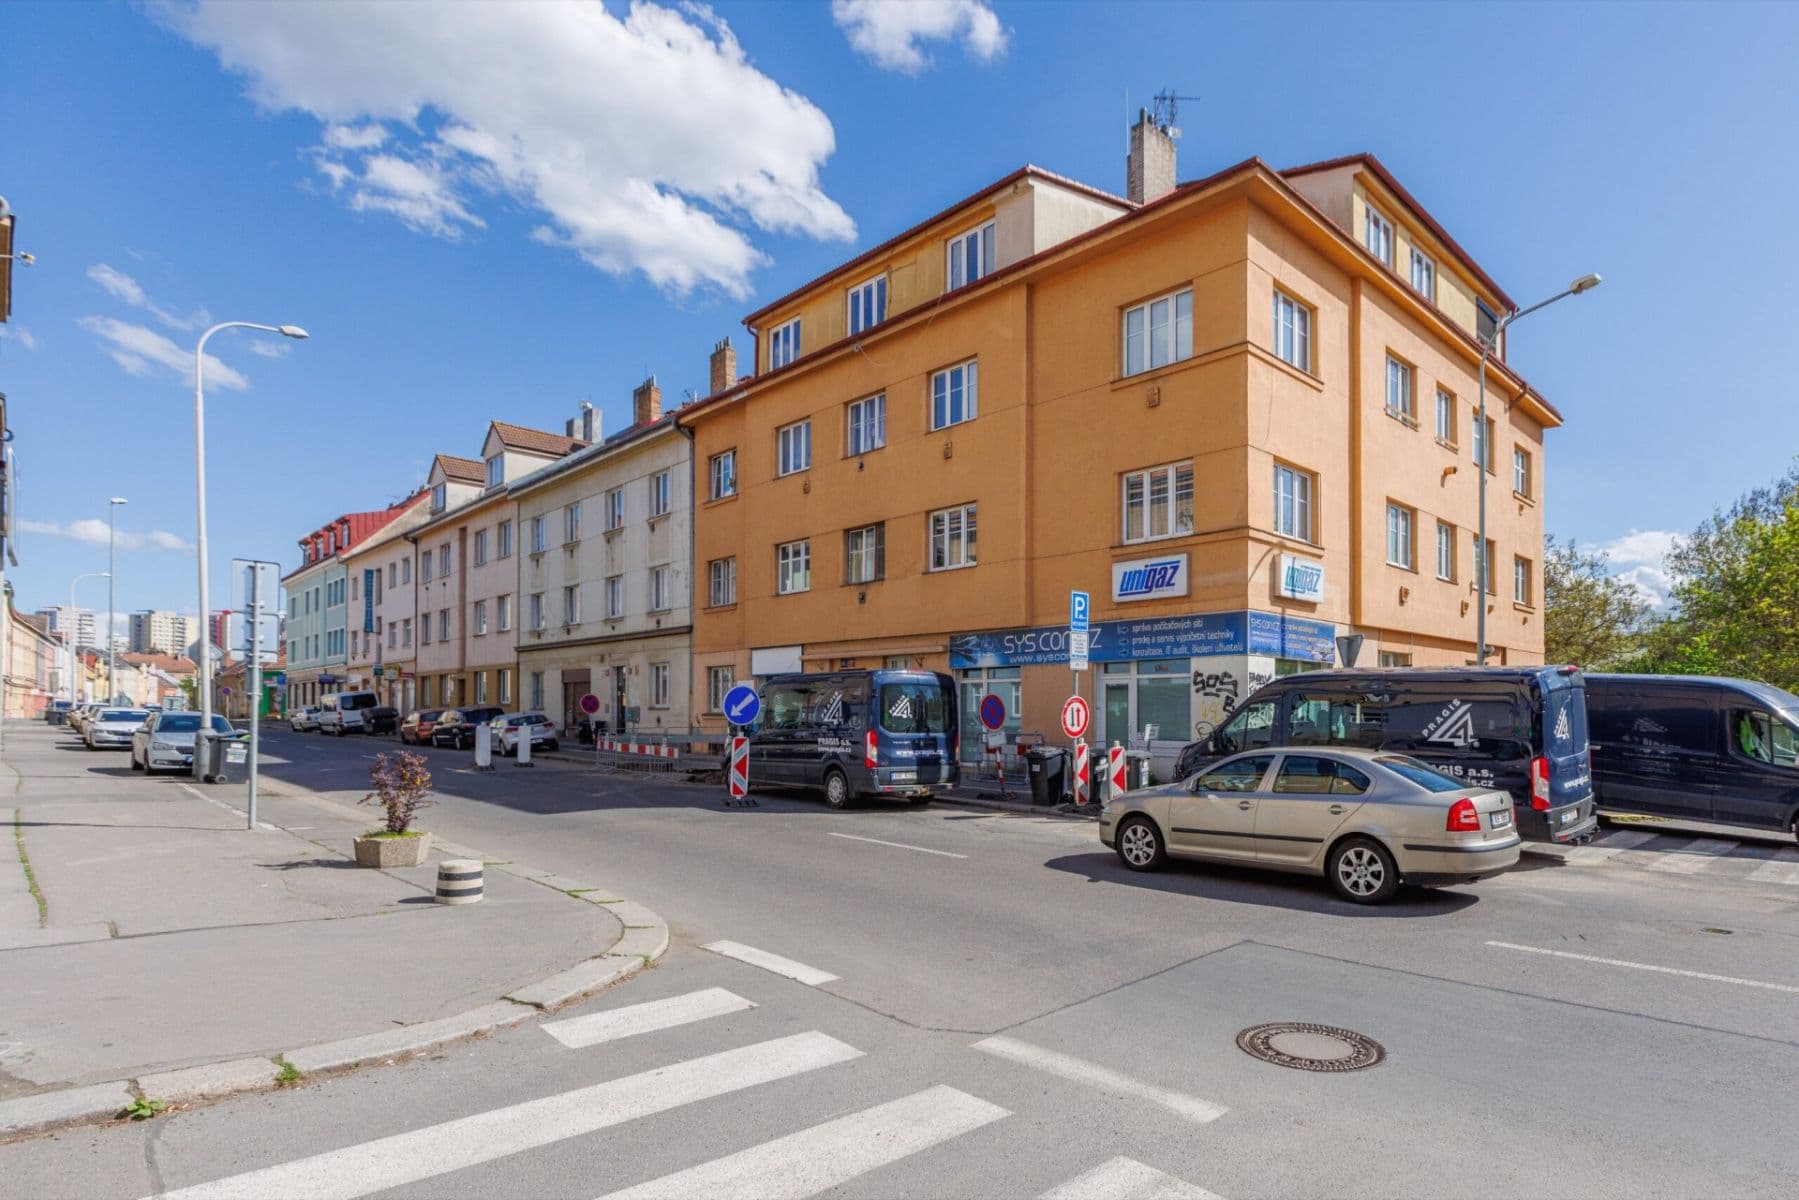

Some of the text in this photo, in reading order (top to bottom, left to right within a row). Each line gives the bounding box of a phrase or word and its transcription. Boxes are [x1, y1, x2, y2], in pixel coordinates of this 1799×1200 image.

[1118, 560, 1181, 597] unigaz
[1284, 564, 1322, 594] unigaz
[1075, 597, 1086, 619] P
[1004, 633, 1036, 654] SYS
[1421, 697, 1461, 738] PRAGIS
[817, 737, 840, 747] PRAGIS
[1467, 767, 1494, 778] a.s.
